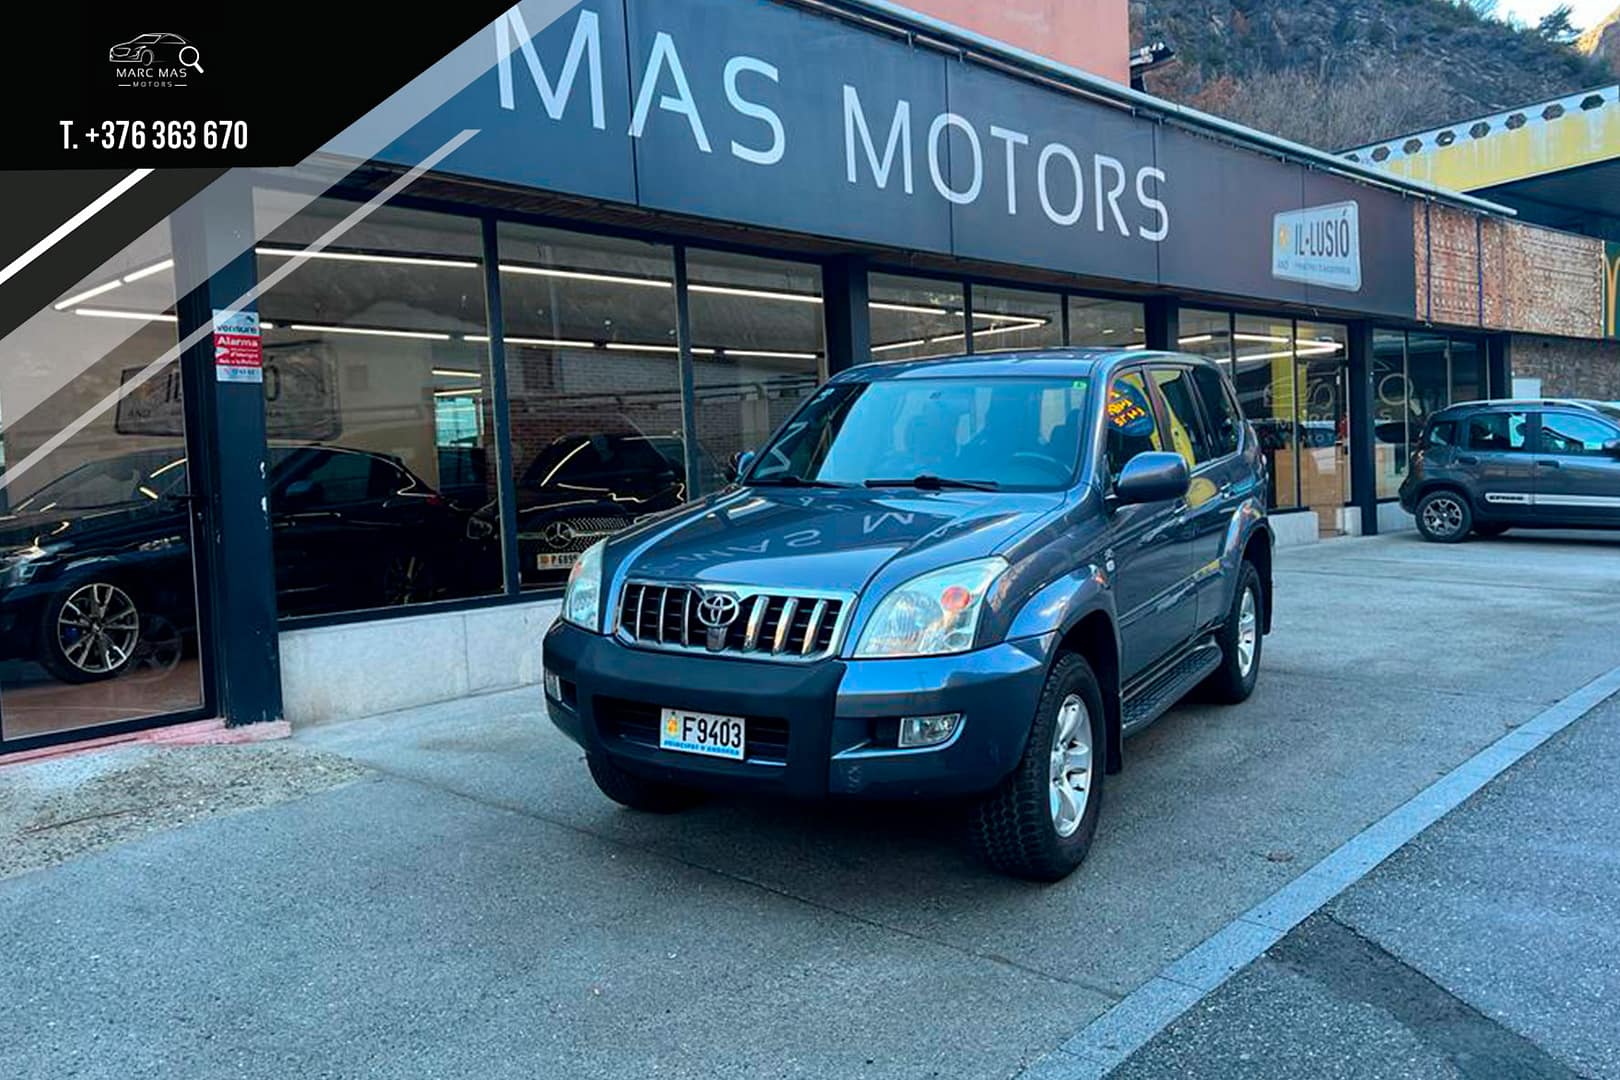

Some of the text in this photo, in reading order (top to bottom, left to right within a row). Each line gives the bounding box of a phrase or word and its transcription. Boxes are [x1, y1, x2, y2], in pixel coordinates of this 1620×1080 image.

[495, 5, 1169, 242] MAS MOTORS
[217, 336, 259, 347] Alarma
[682, 716, 742, 748] F9403
